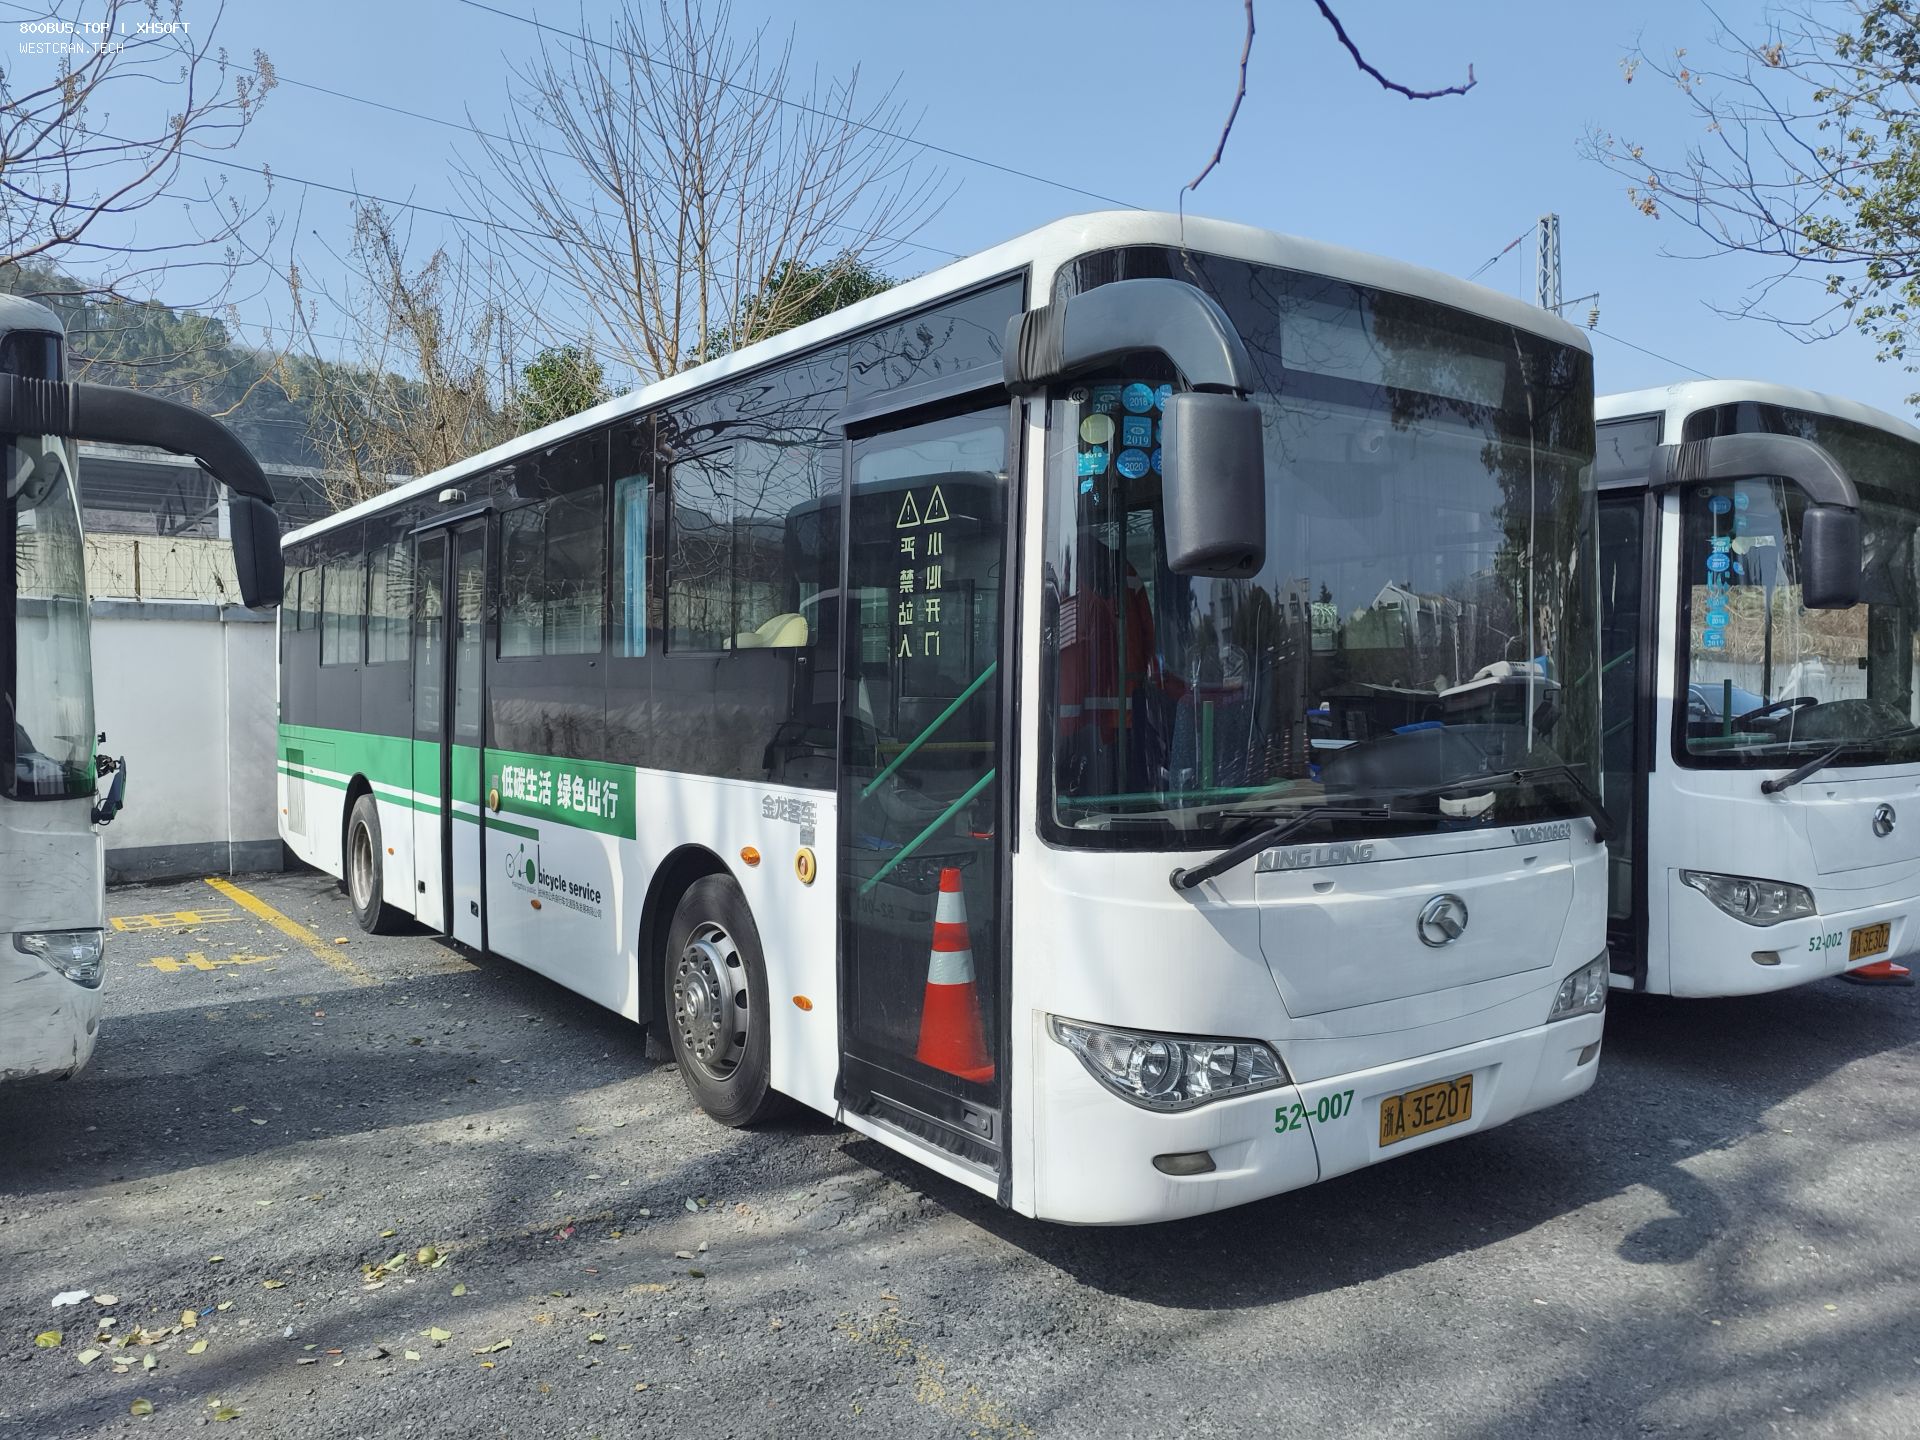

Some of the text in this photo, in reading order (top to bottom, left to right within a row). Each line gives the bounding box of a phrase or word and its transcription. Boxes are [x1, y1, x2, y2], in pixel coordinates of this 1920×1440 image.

[1126, 435, 1149, 445] 2019
[1124, 462, 1144, 472] 2020
[501, 764, 619, 819] 低碳生活 绿色出行
[1256, 843, 1375, 870] KING LONG
[537, 859, 602, 904] bicycle service
[1808, 931, 1843, 952] 52-002
[1274, 1089, 1355, 1134] 52-007
